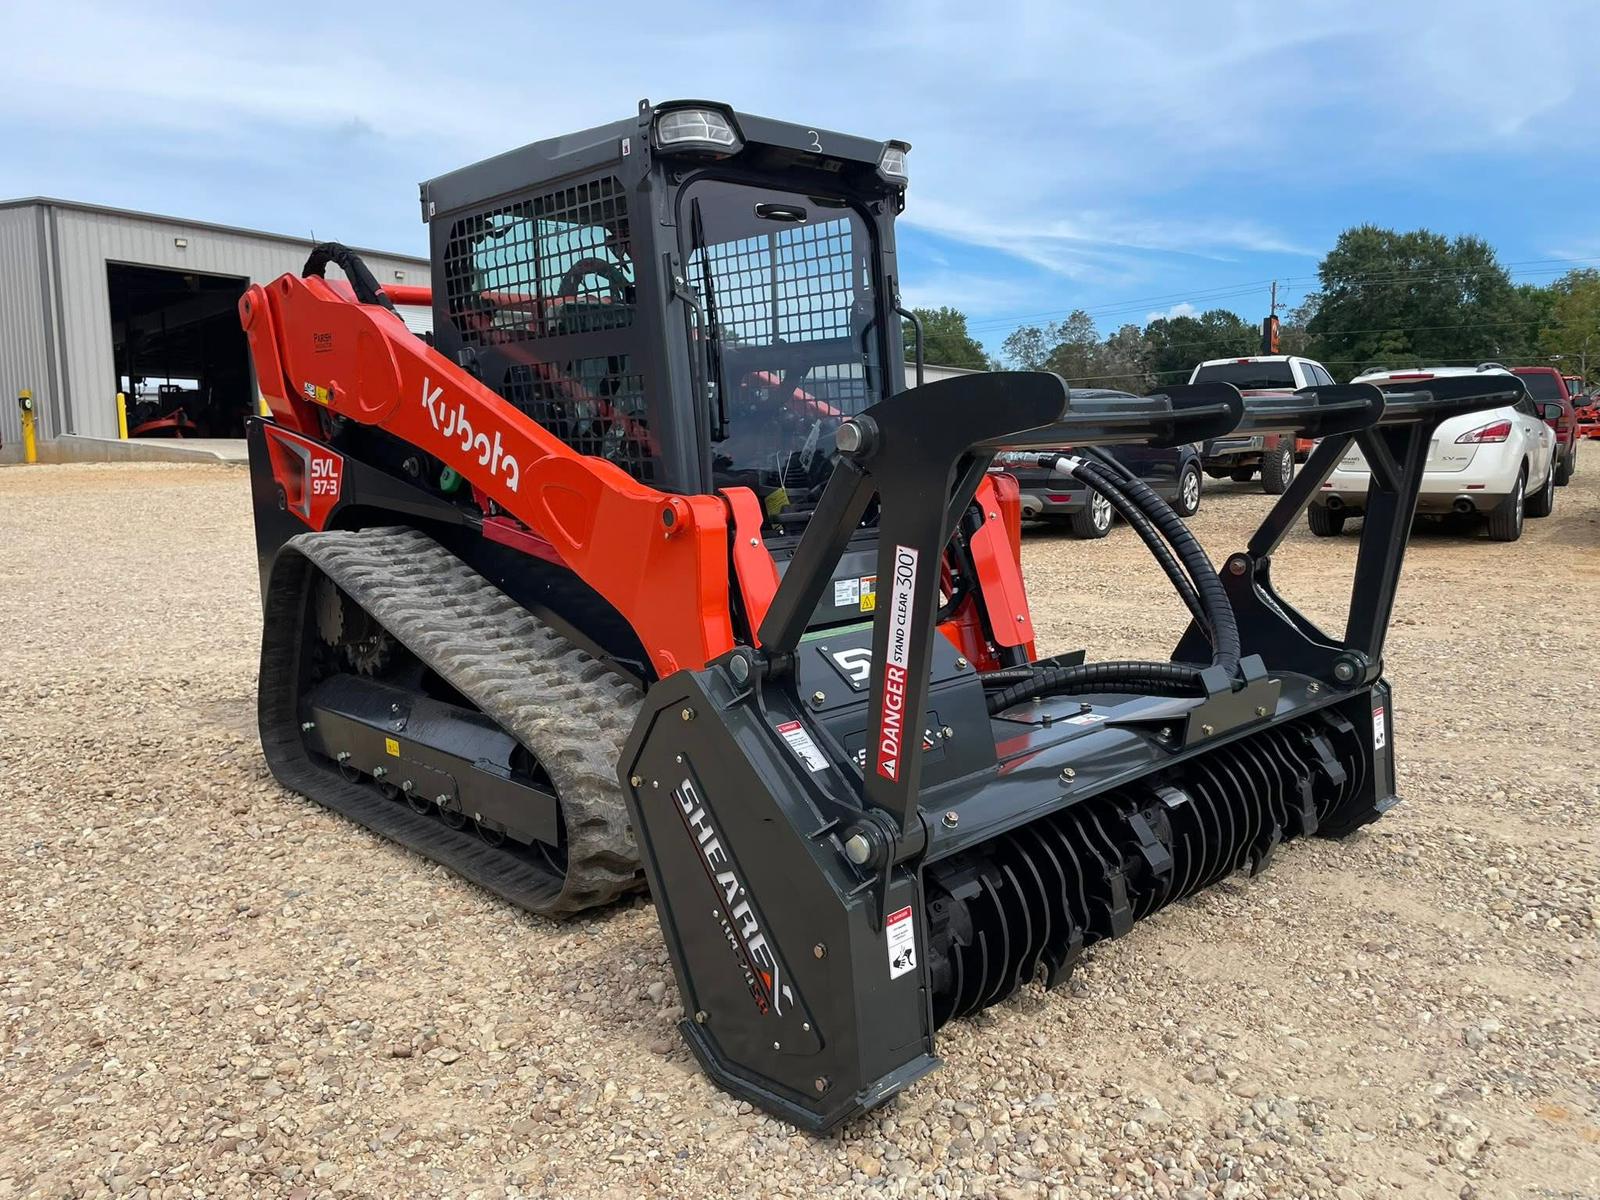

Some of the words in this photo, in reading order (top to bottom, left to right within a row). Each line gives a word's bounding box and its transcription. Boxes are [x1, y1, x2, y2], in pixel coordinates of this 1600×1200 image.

[808, 130, 823, 153] 3
[421, 376, 519, 493] Kubota
[311, 458, 339, 478] SVL
[313, 479, 337, 495] 97-3
[897, 592, 908, 626] CLEAR
[893, 628, 904, 663] STAND
[882, 667, 905, 757] DANGER
